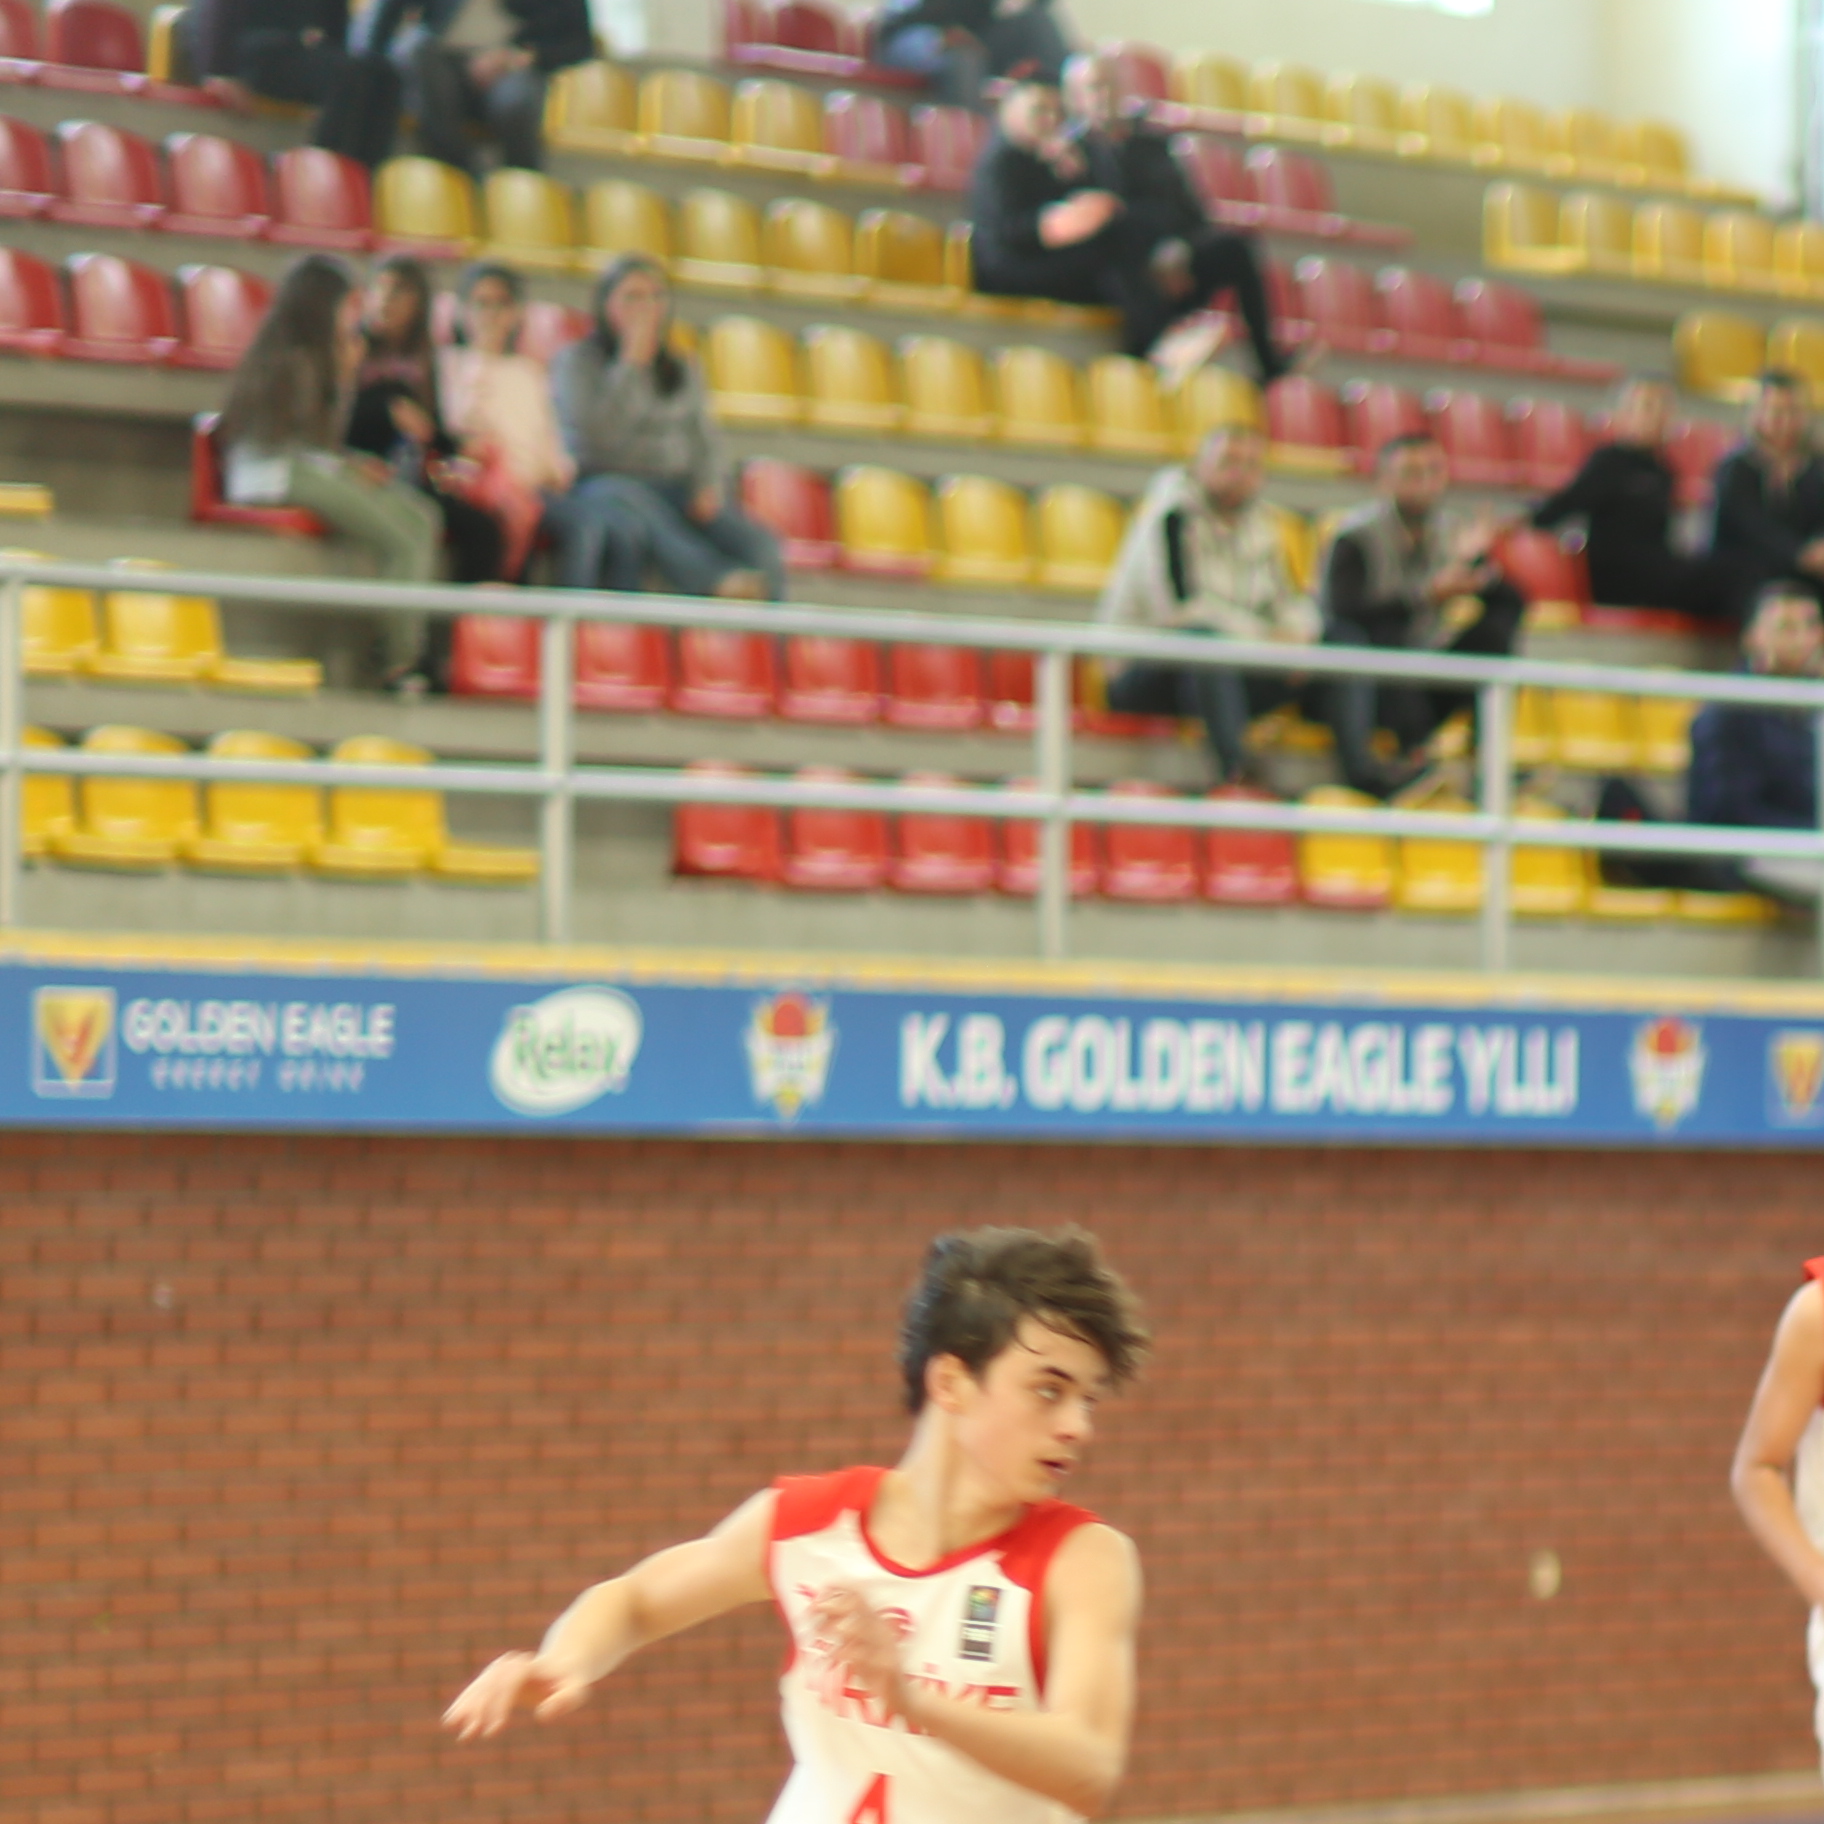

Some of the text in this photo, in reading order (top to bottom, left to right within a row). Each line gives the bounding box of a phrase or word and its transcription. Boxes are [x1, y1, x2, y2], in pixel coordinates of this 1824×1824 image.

[123, 999, 397, 1060] GOLDEN EAGLE
[898, 1011, 1581, 1118] K.B. GOLDEN EAGLE YLLI
